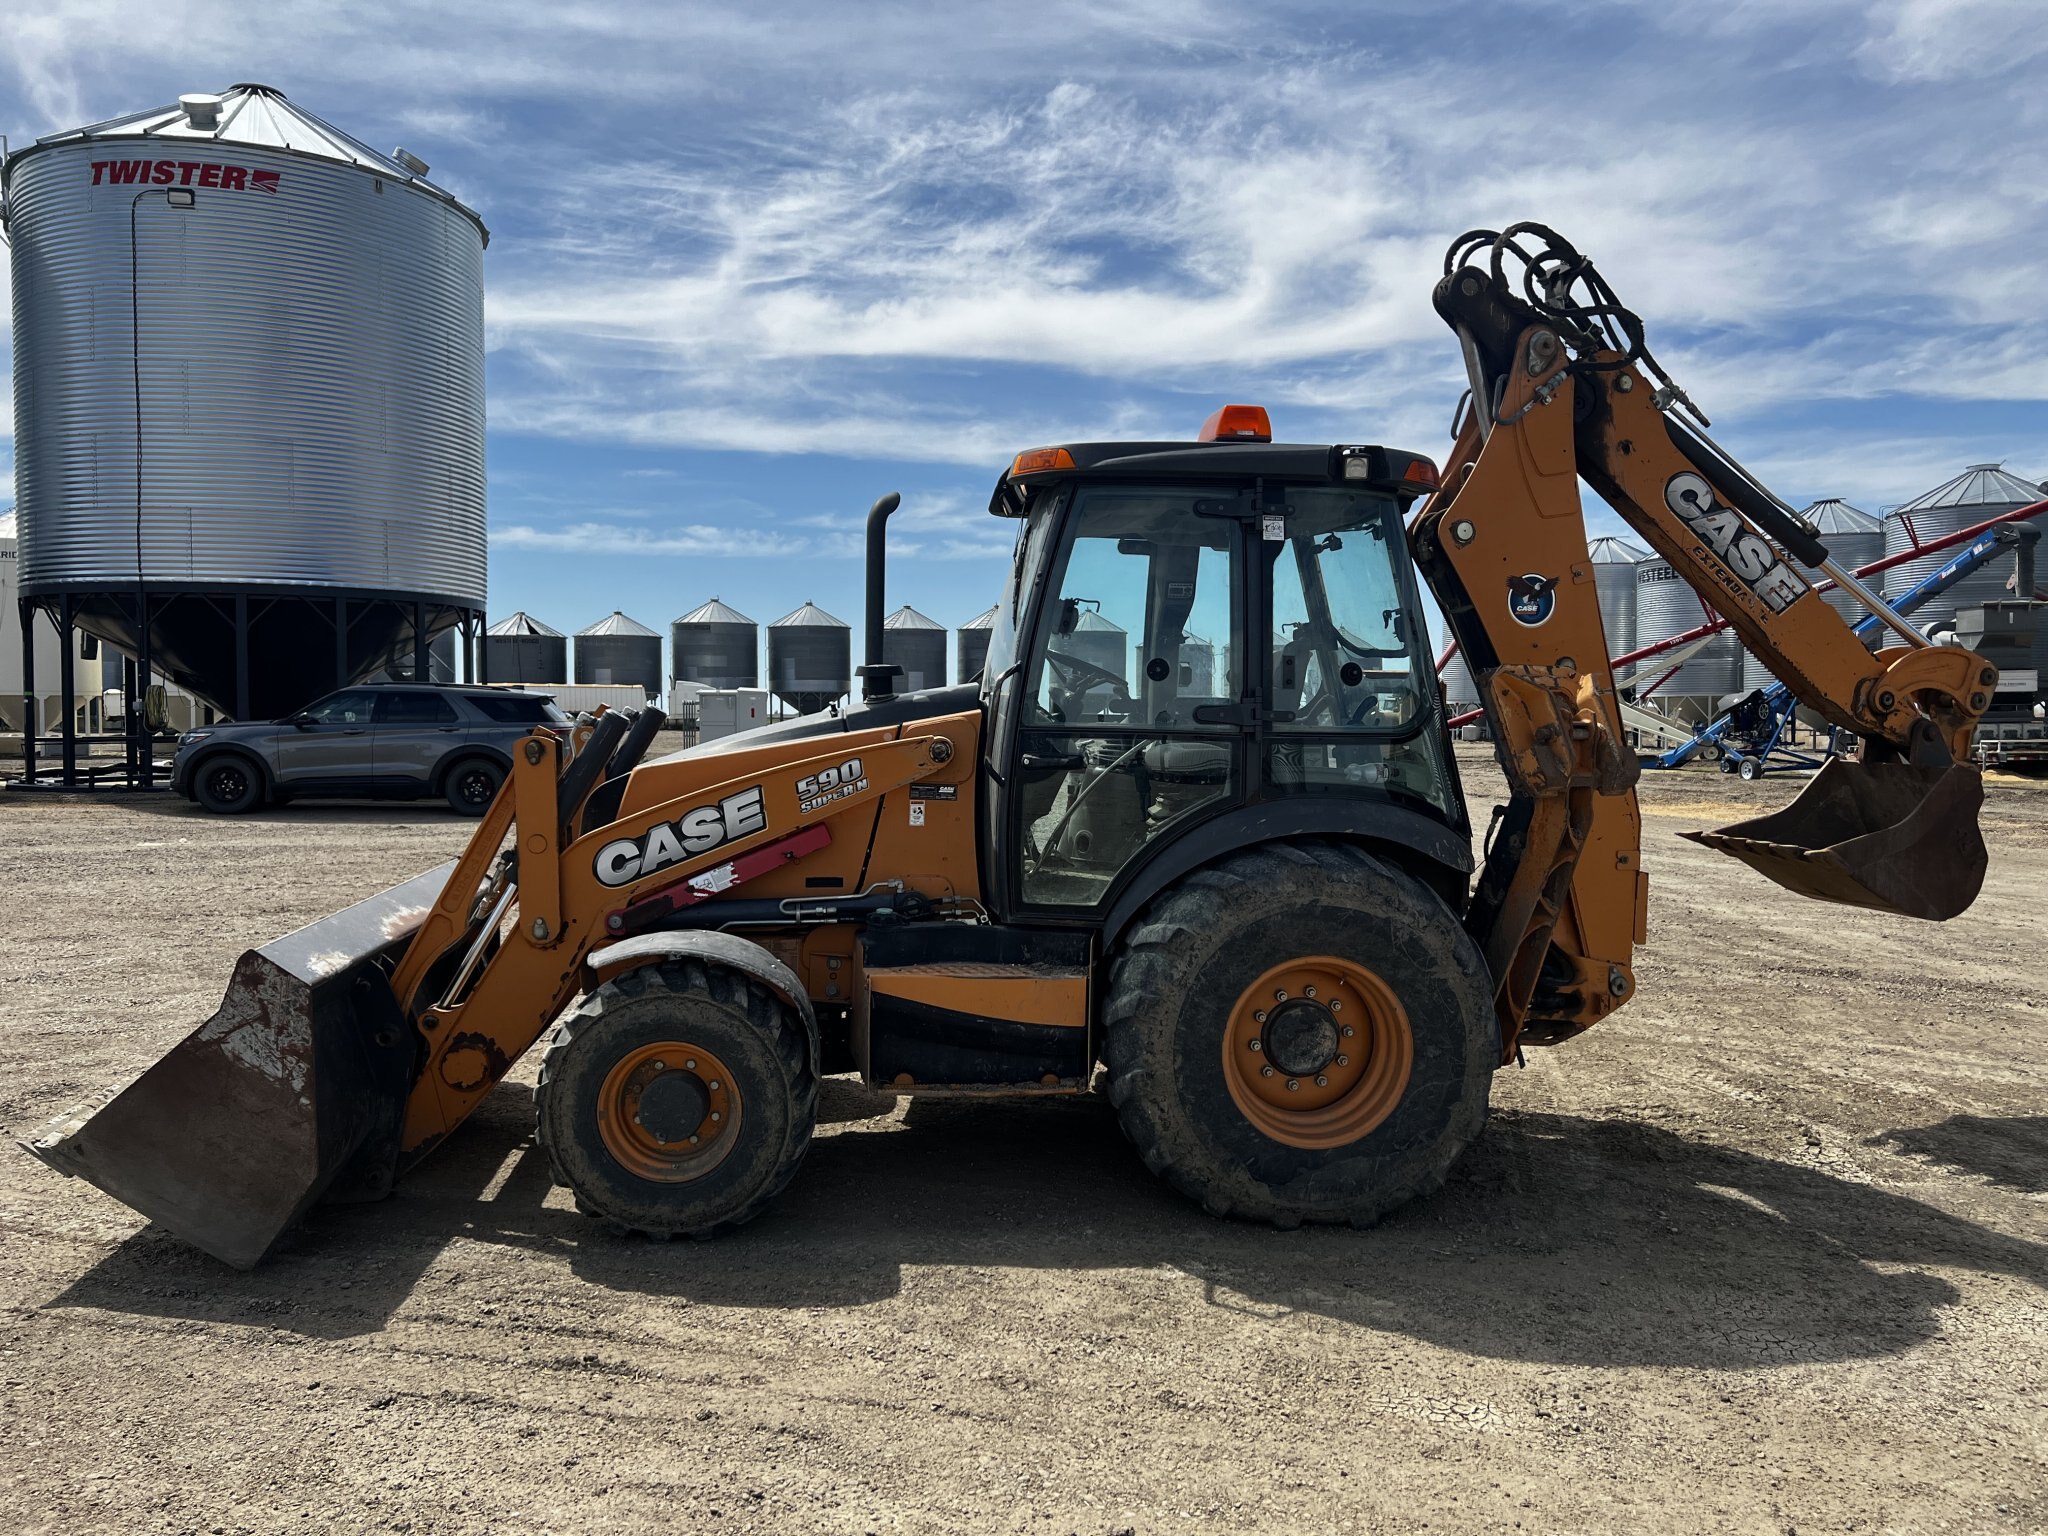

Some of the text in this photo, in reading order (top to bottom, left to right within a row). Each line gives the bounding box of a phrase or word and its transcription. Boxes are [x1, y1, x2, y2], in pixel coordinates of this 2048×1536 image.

[91, 160, 248, 190] TWISTER
[1665, 472, 1809, 615] CASE
[795, 758, 864, 802] 590
[800, 777, 869, 814] SUPER N
[593, 784, 767, 888] CASE
